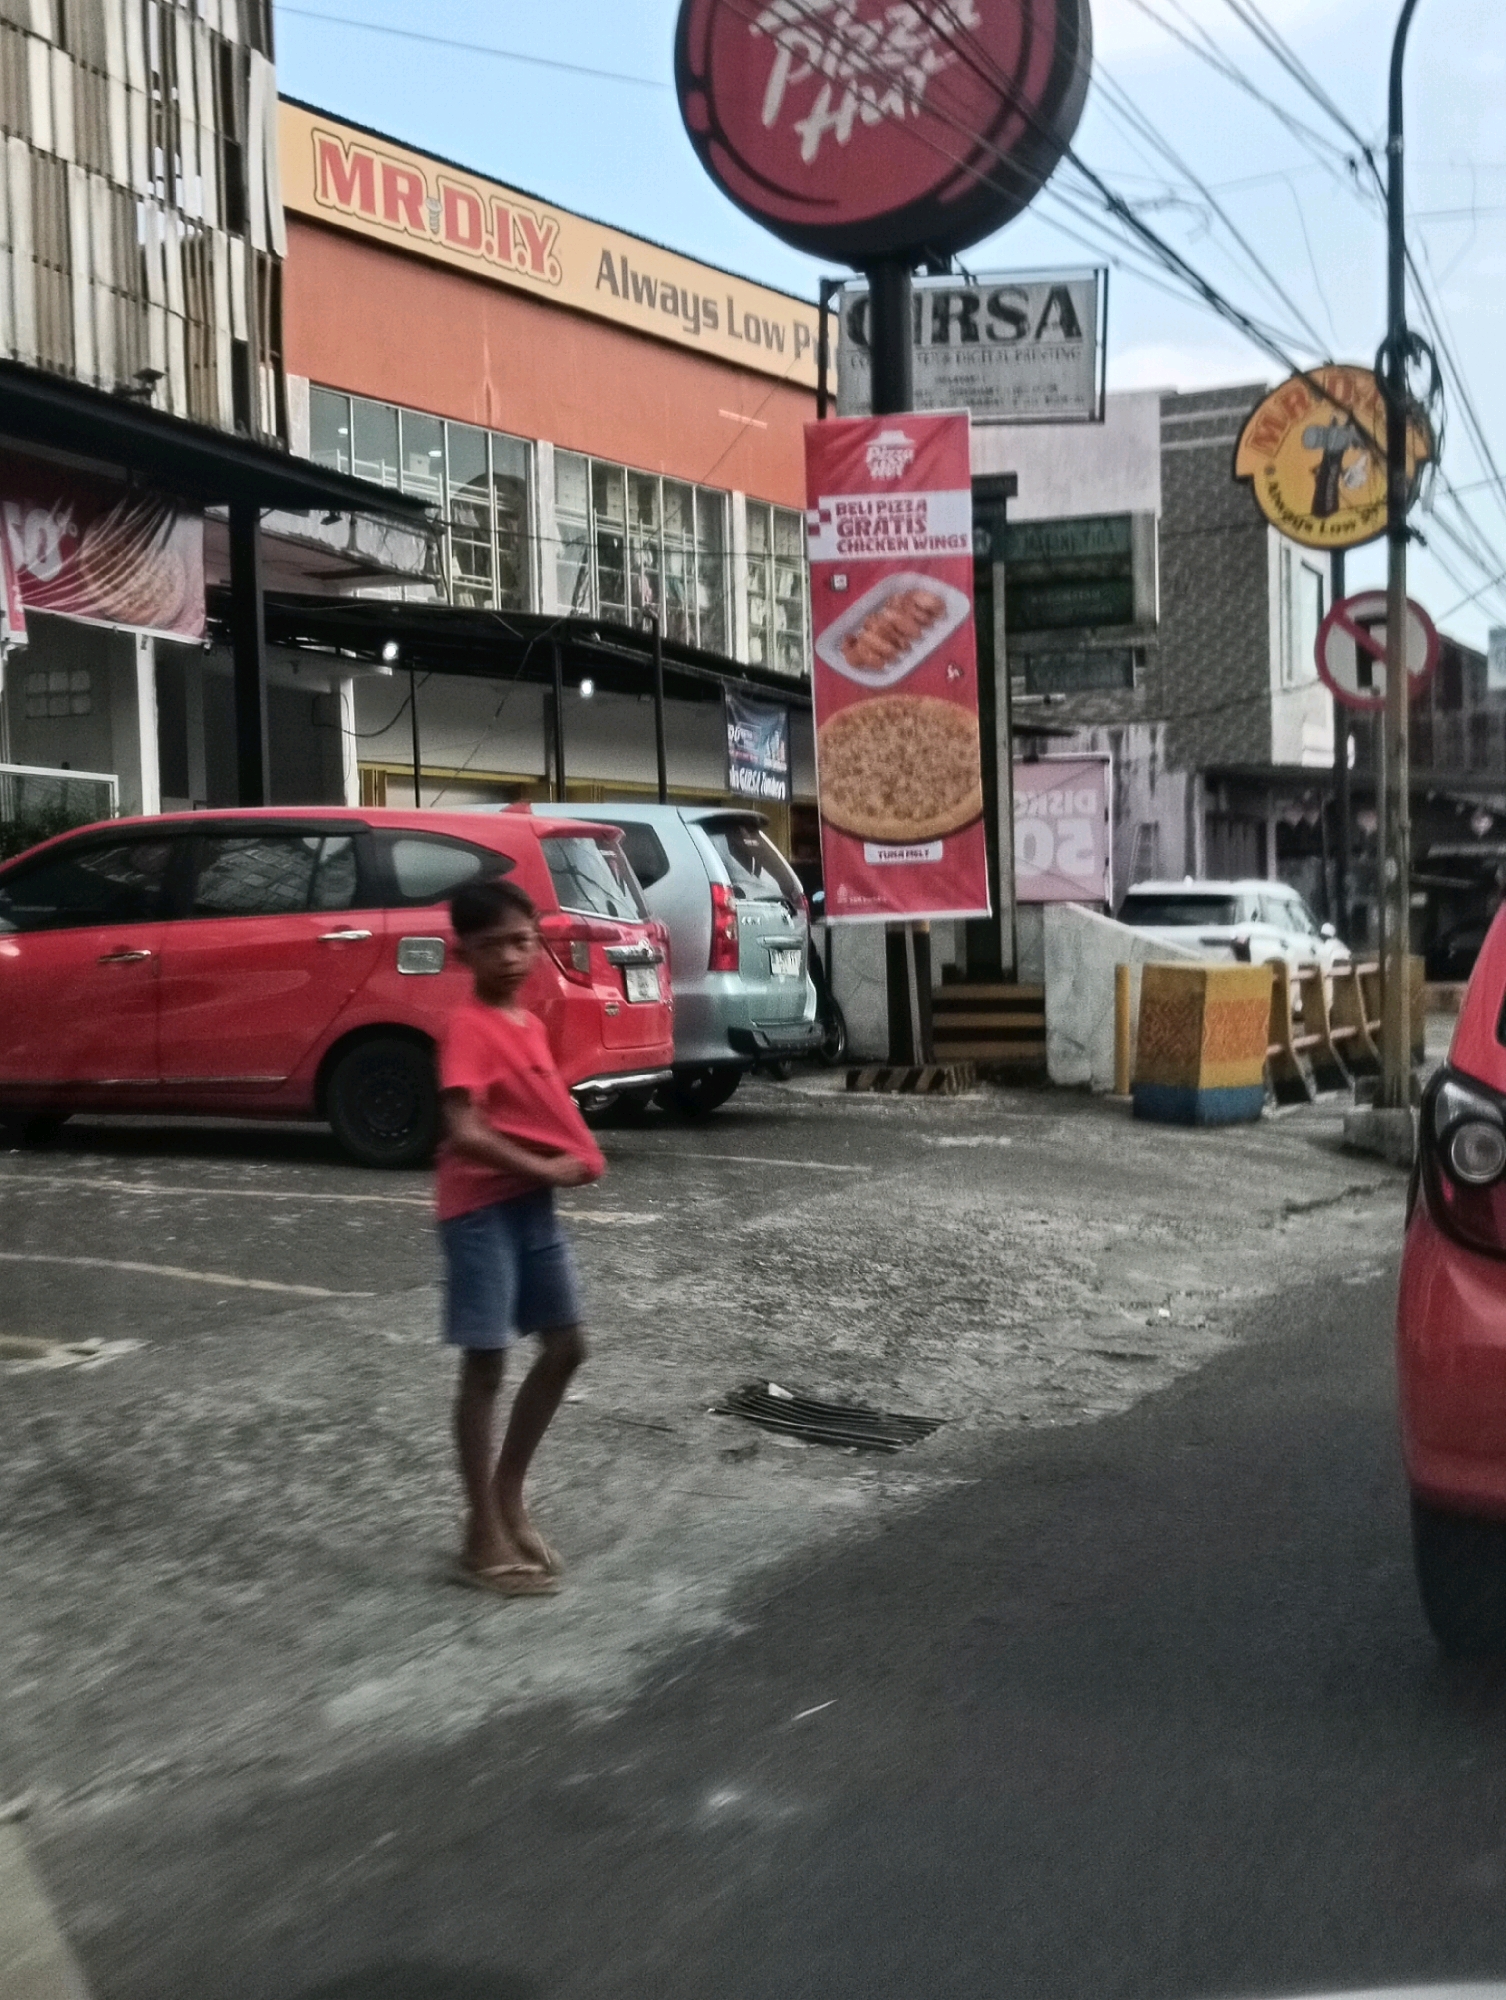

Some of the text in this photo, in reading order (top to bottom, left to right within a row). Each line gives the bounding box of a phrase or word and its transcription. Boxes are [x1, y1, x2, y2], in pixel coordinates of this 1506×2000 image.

[596, 249, 719, 336] Always
[727, 295, 786, 354] Low
[836, 499, 927, 517] BELI PIZZA
[836, 516, 927, 538] GRATIS
[836, 533, 968, 555] CHICKEN WINGS
